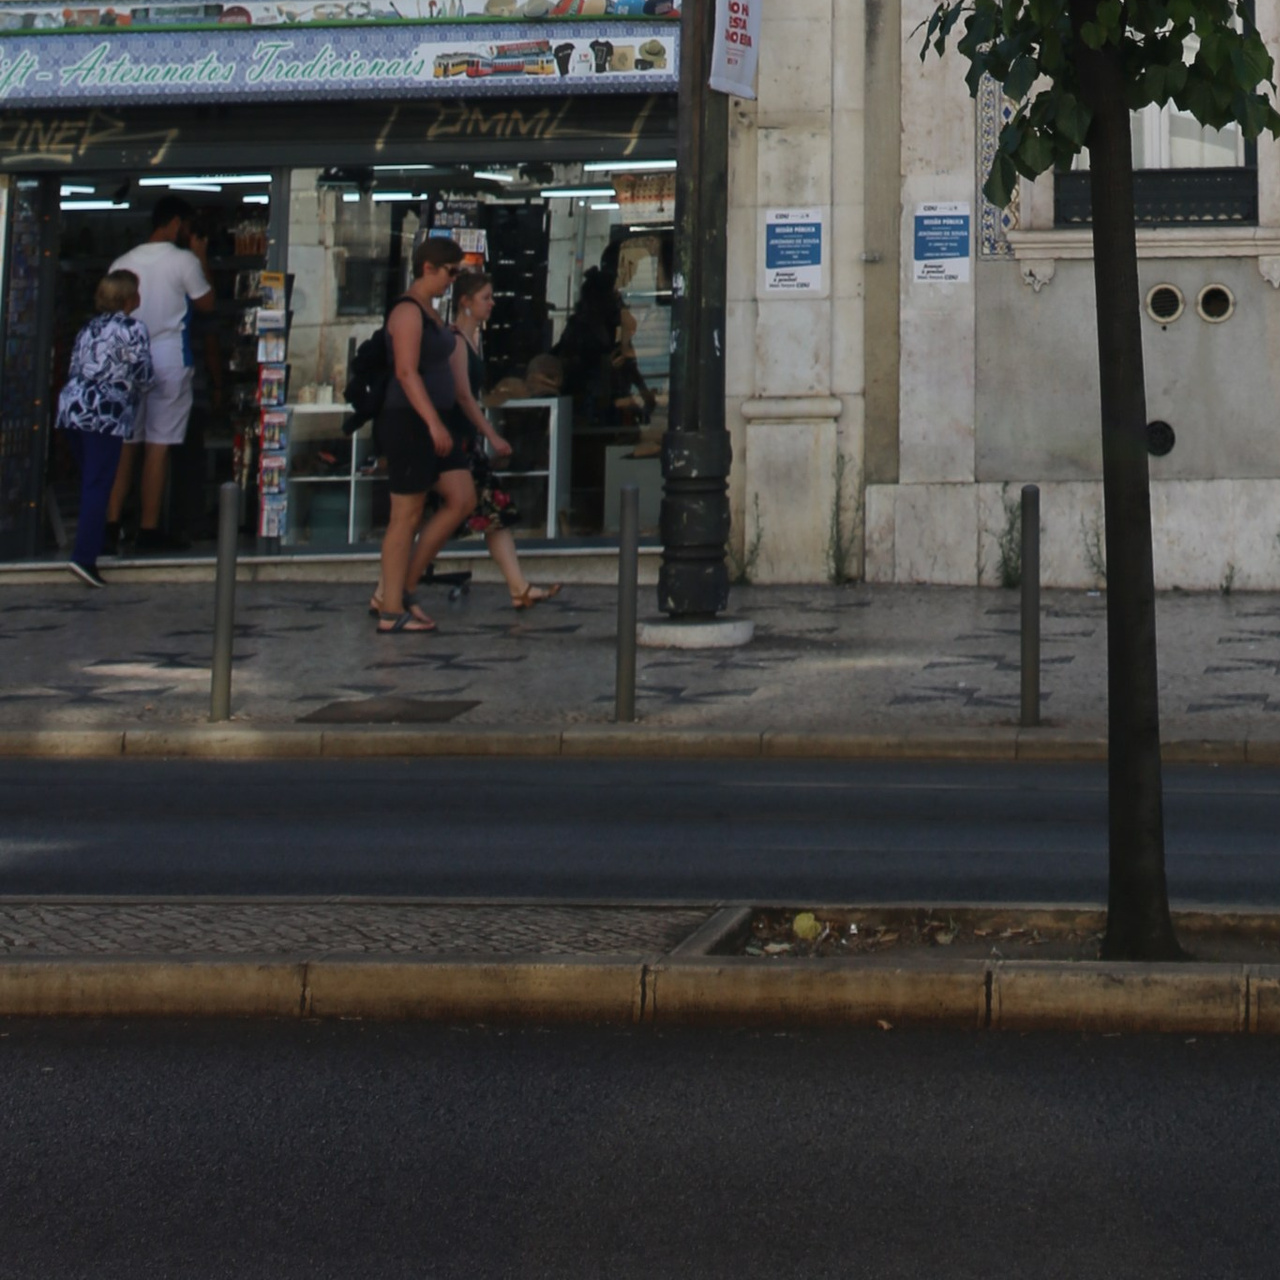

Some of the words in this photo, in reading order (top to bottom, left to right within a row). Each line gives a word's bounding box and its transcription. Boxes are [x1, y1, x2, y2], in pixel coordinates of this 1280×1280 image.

[0, 49, 38, 100] ift
[60, 42, 235, 86] Artesanatos
[247, 42, 426, 84] Tradicionais
